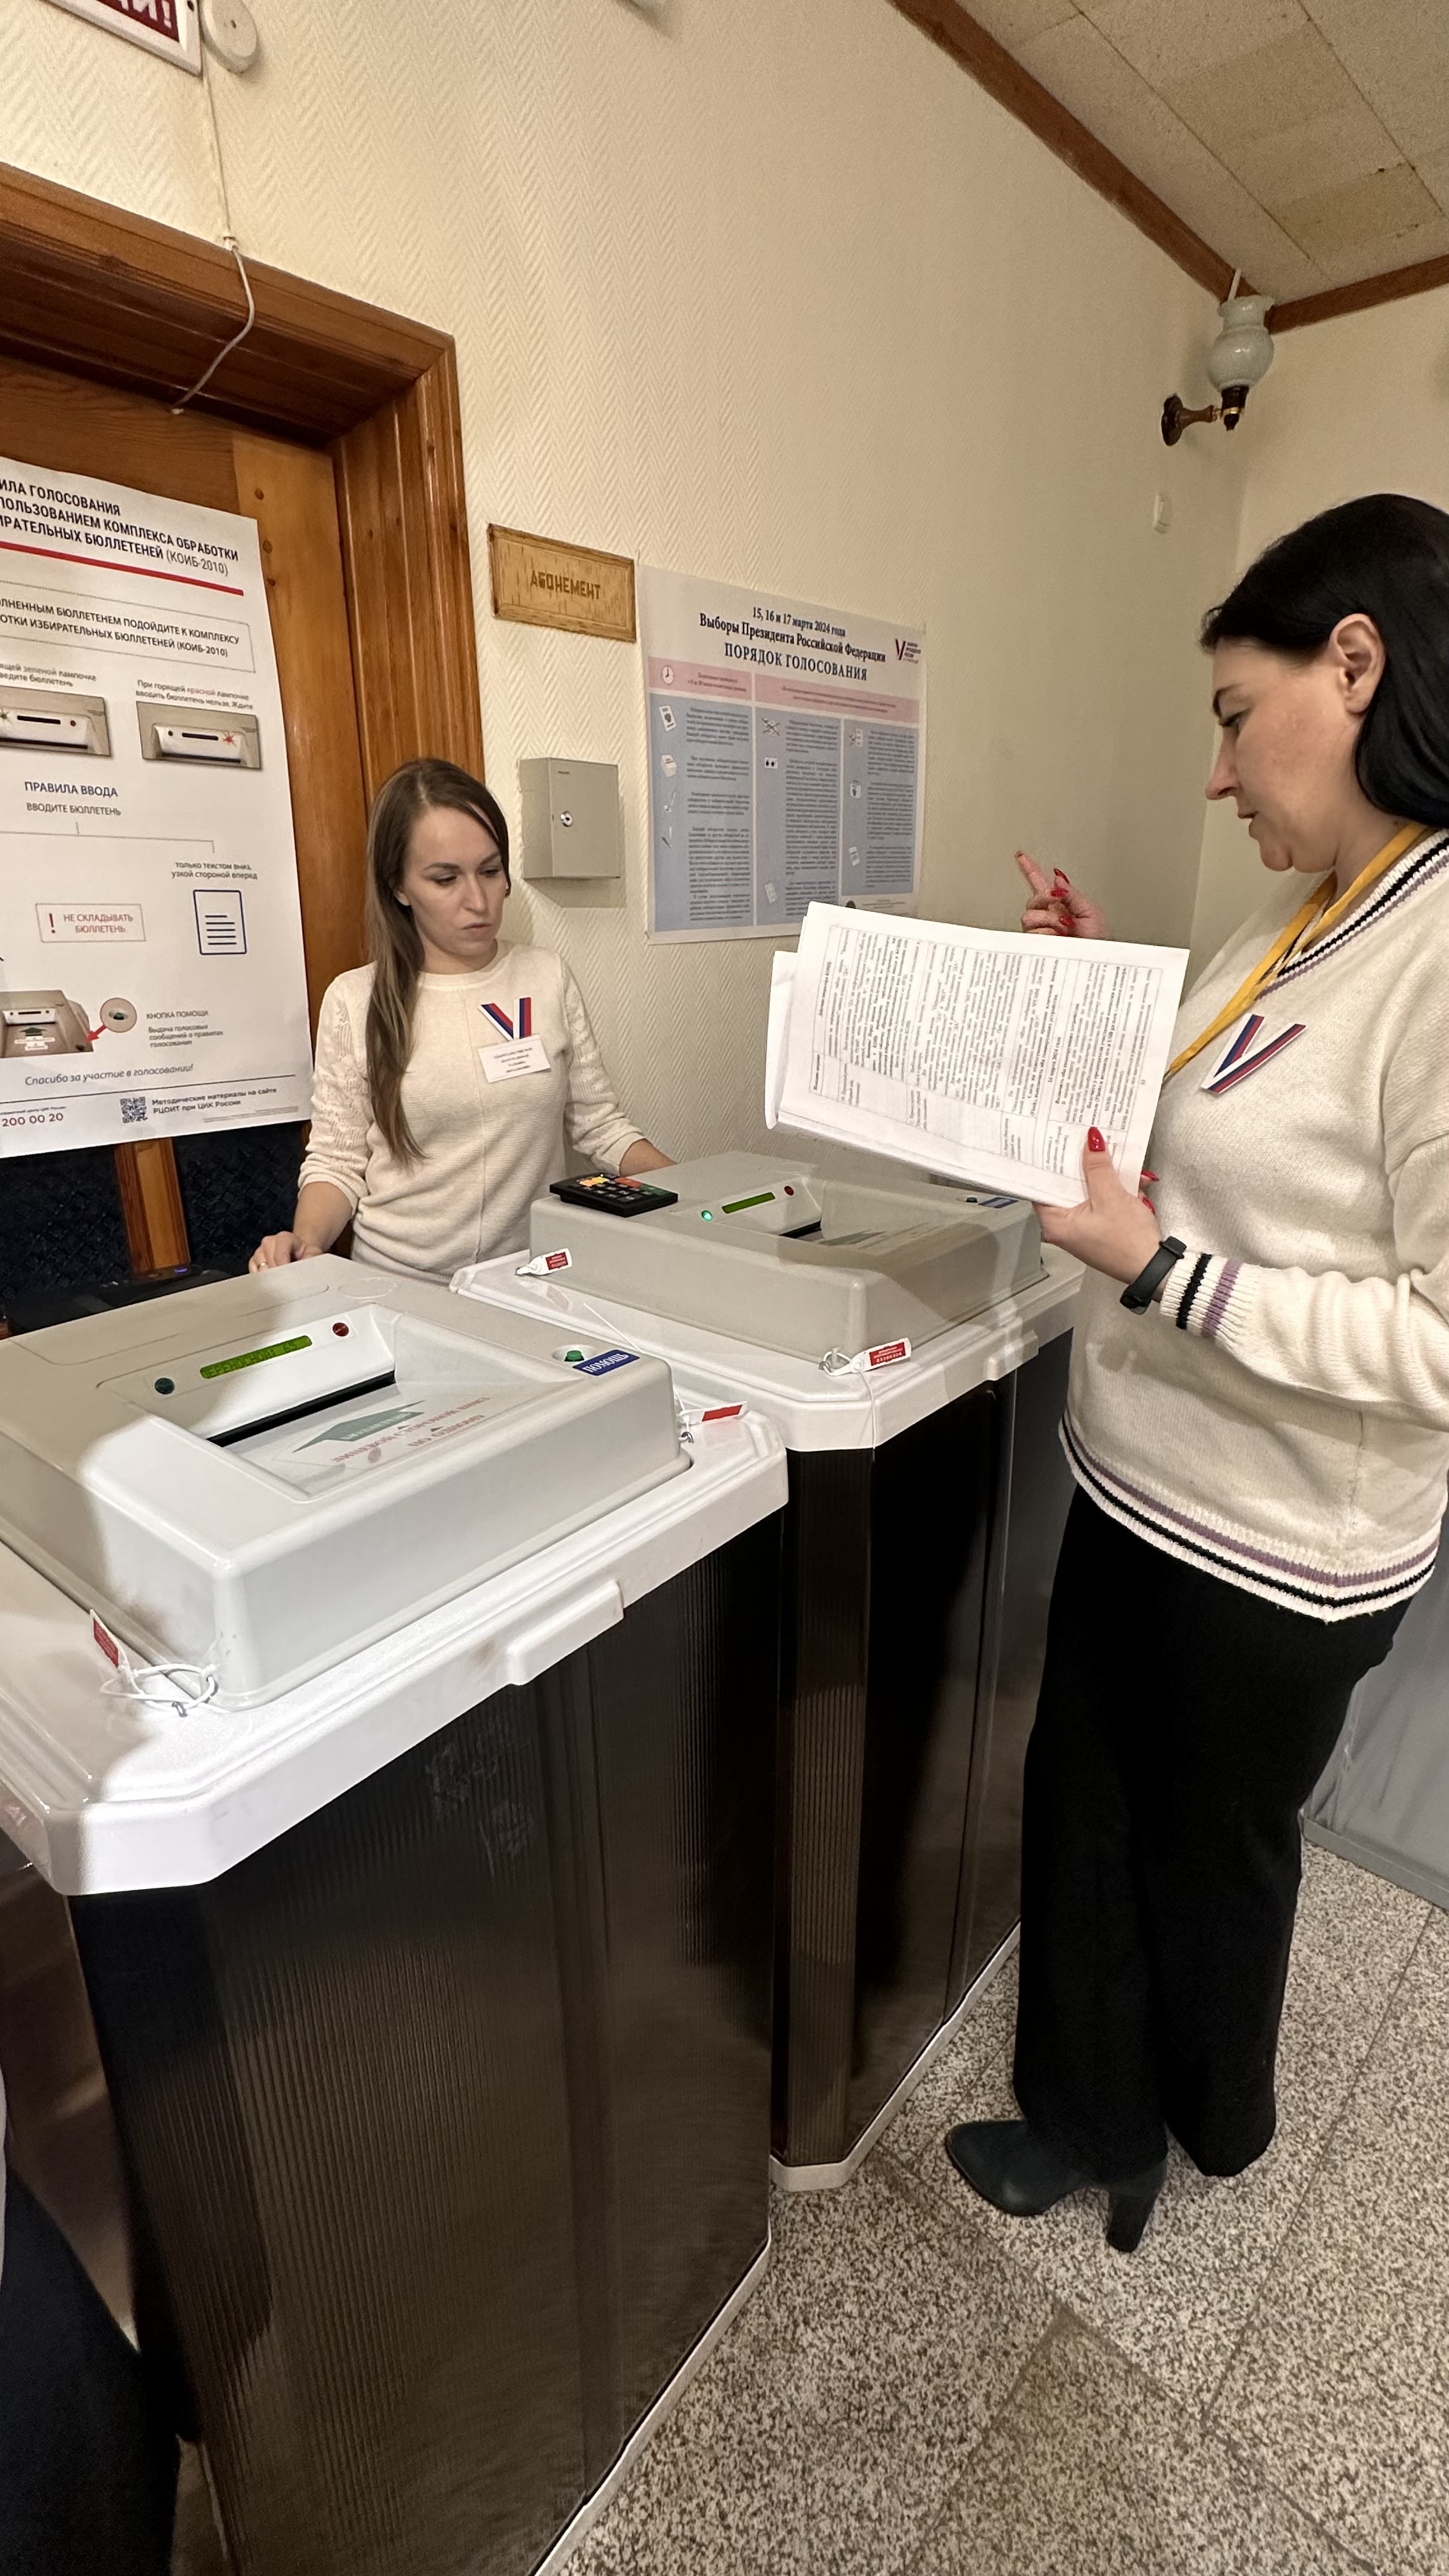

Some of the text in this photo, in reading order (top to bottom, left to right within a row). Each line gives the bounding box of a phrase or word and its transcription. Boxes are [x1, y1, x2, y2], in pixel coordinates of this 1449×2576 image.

[29, 484, 121, 516] ГОЛОСОВАНИЯ
[103, 519, 174, 546] КОМПЛЕКСА
[176, 537, 239, 562] ОБРАБОТКИ
[85, 532, 164, 560] БЮЛЛЕТЕНЕЙ
[166, 549, 228, 577] (КОИБ-2010)
[530, 570, 601, 600] АБОНЕМЕНТ
[0, 598, 240, 645] ЛНЕННЫМ БЮЛЛЕТЕНЕМ ПОДОЙДИТЕ К КОМПЛЕКСУ
[753, 606, 846, 638] 15, 16 и 17 марта 2024 года
[30, 618, 113, 639] ИЗБИРАТЕЛЬНЫХ
[115, 631, 175, 648] БЮЛЛЕТЕНЕЙ
[177, 641, 228, 658] (КОИБ-2010)
[700, 613, 740, 636] Выборы
[741, 622, 795, 644] Президента
[797, 632, 843, 654] Российской
[845, 643, 886, 663] Федерации
[724, 642, 868, 681] ПОРЯДОК ГОЛОСОВАНИЯ
[29, 674, 73, 687] бюллетень
[137, 680, 153, 689] При
[25, 781, 118, 798] ПРАВИЛА ВВОДА
[27, 802, 121, 816] ВВОДИТЕ БЮЛЛЕТЕНЬ
[171, 870, 194, 879] узкой
[195, 871, 230, 880] стороной
[64, 914, 133, 923] НЕ СКЛАДЫВАТЬ
[75, 924, 126, 933] БЮЛЛЕТЕНЬ
[25, 1073, 68, 1085] Спасибо
[83, 1070, 125, 1082] участие
[134, 1063, 194, 1077] голосовании!
[152, 1094, 206, 1106] Методические
[207, 1091, 247, 1100] материалы
[153, 1105, 180, 1114] РЦОИТ
[197, 1102, 213, 1110] ЦИК
[1, 1112, 64, 1127] 200 00 20
[582, 1353, 629, 1373] ПОМОЩЬ
